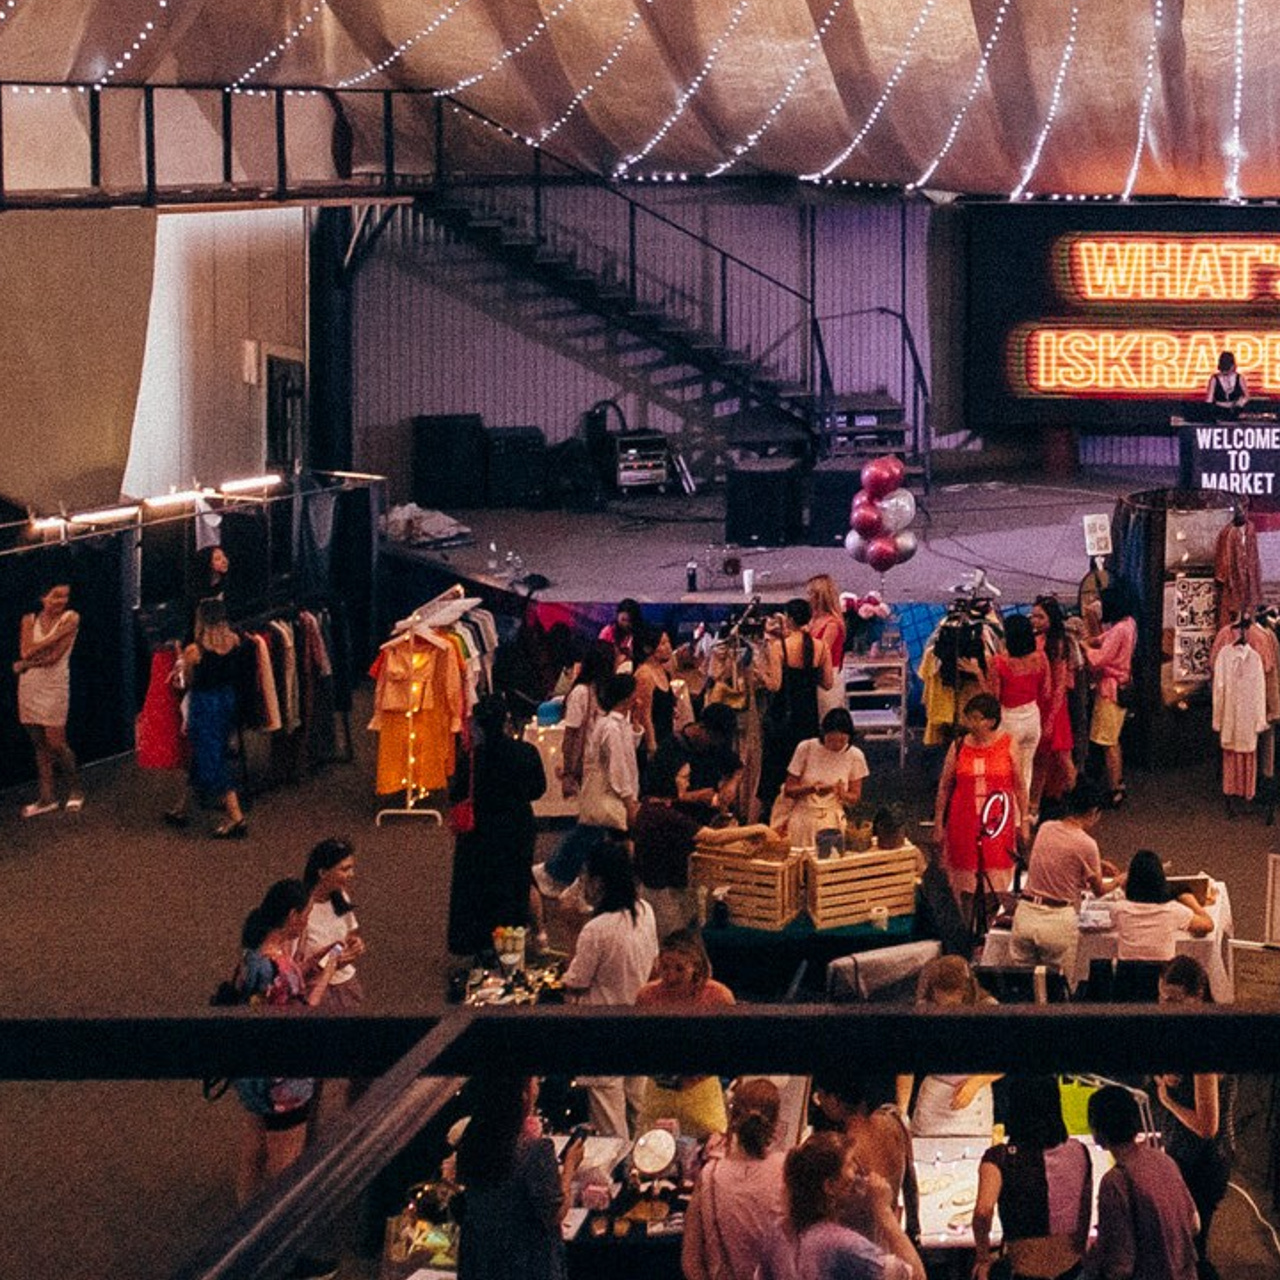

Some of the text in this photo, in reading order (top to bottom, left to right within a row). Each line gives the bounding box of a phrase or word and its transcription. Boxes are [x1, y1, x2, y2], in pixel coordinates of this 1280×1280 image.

[1196, 427, 1280, 450] WELCOME
[1227, 449, 1251, 472] TO
[1201, 472, 1276, 495] MARKET
